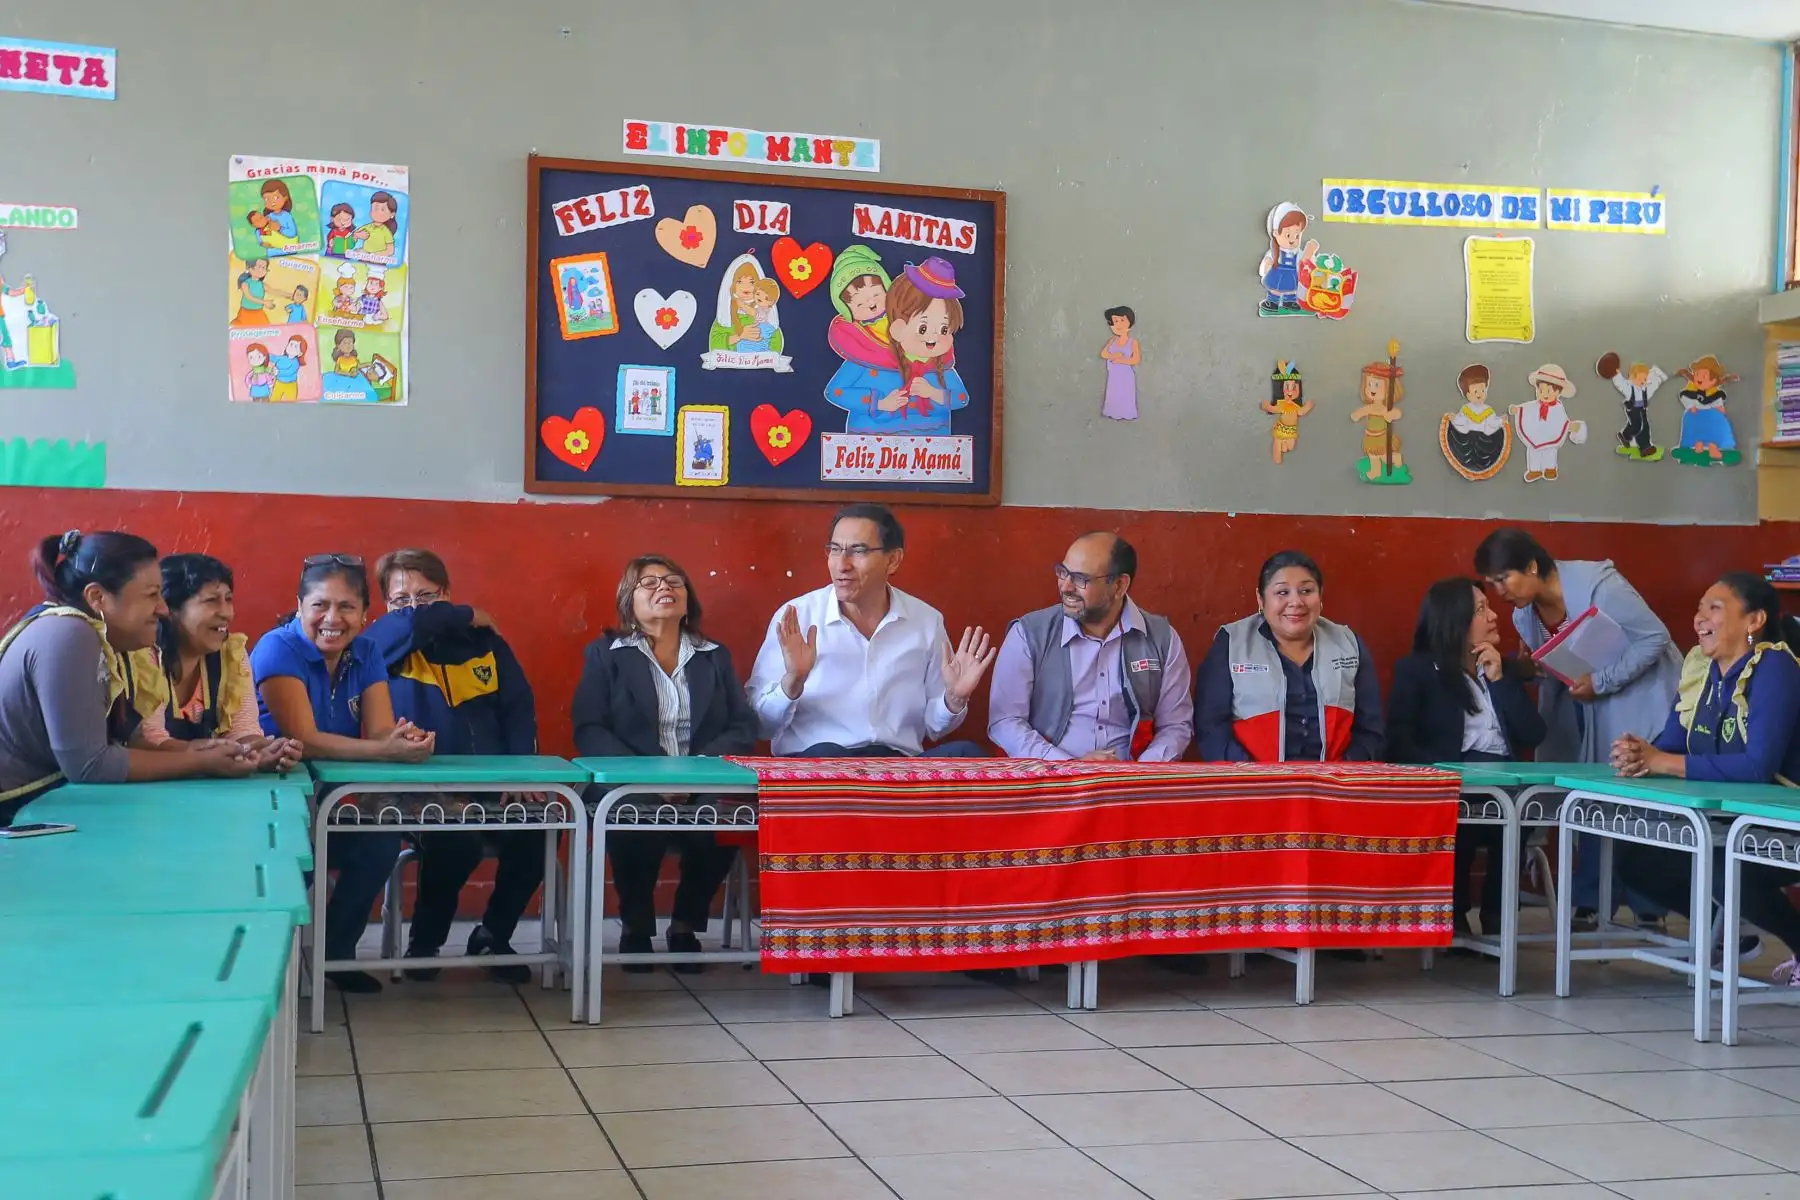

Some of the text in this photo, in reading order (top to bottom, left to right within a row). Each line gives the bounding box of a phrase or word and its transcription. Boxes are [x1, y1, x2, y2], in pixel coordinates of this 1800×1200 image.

[626, 122, 875, 168] EL INFORMANTE
[247, 164, 300, 178] Gracias
[306, 162, 346, 176] mamá
[555, 188, 974, 249] FELIZ DIA MAMITAS
[1327, 188, 1492, 217] ORGULLOSO
[1501, 196, 1537, 221] DE
[1551, 197, 1581, 222] MI
[834, 445, 876, 469] Feliz
[911, 446, 961, 470] Mamá
